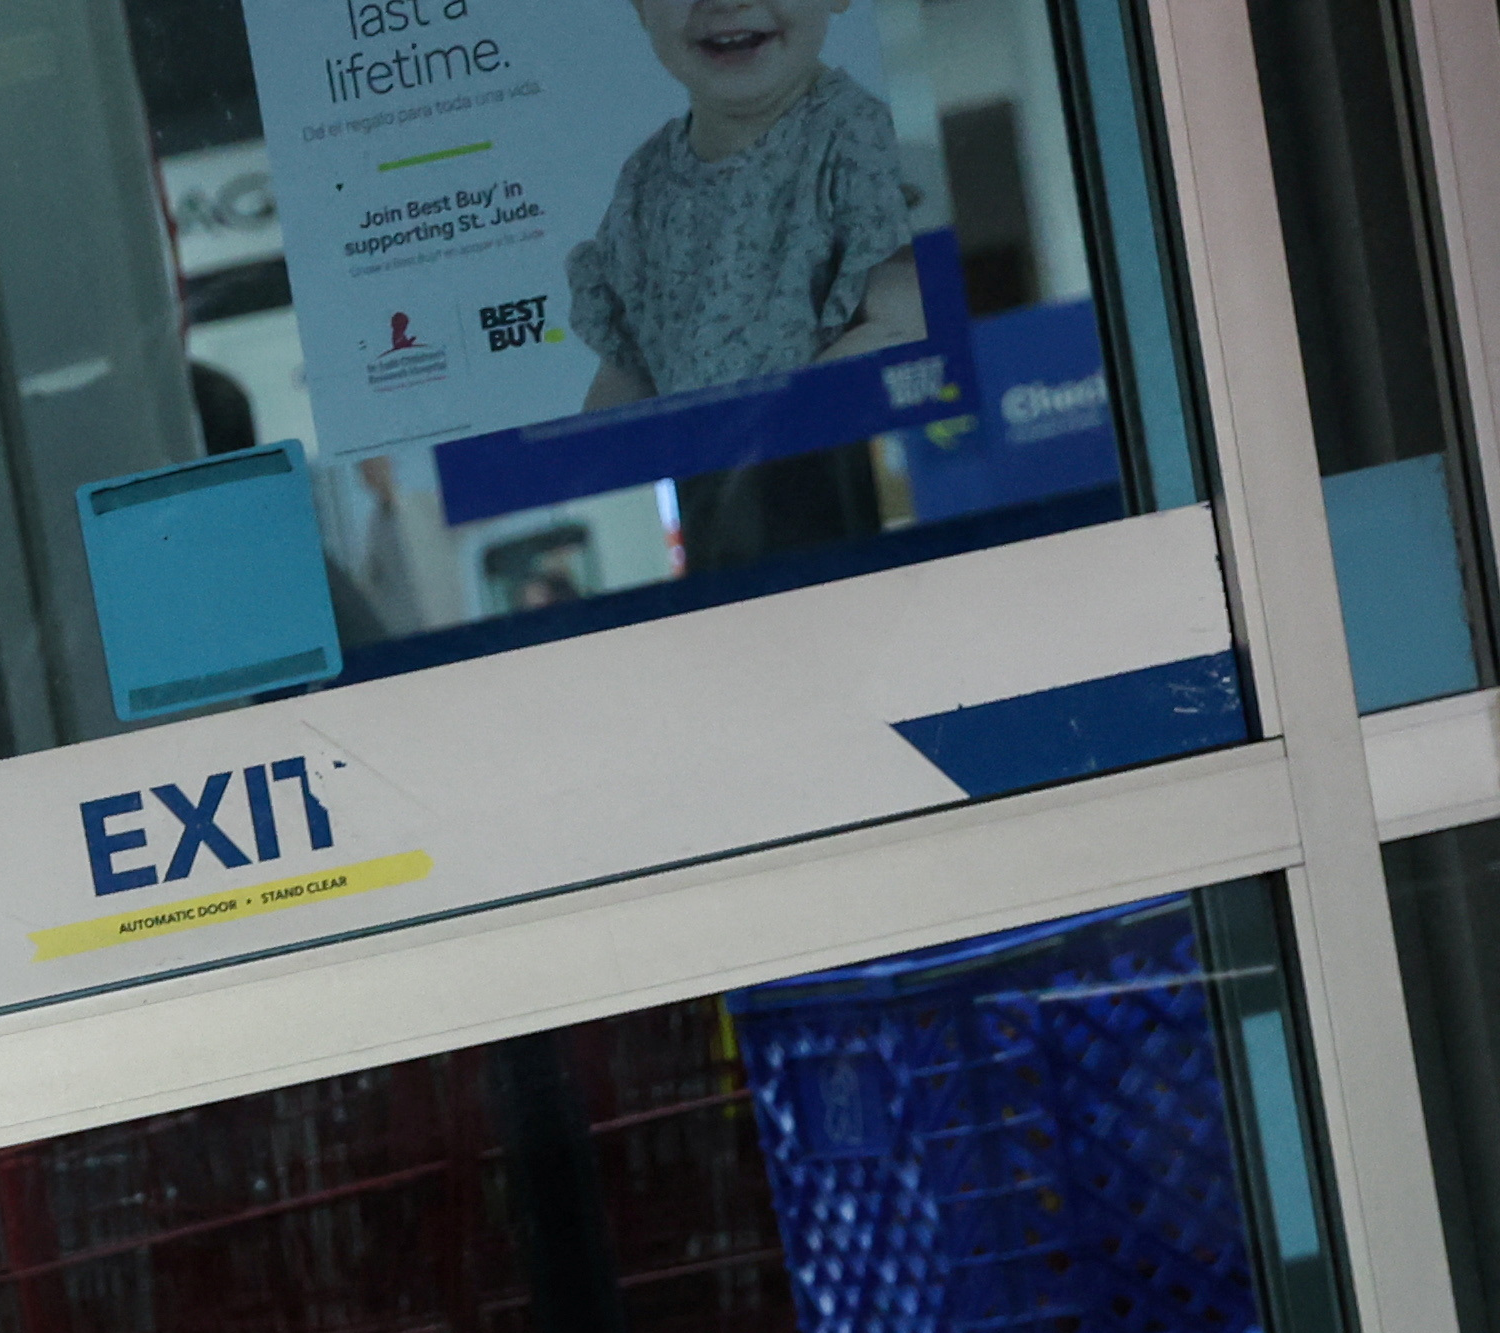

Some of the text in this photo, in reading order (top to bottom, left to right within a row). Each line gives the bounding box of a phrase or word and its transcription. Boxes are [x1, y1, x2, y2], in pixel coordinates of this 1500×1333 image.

[347, 0, 430, 40] last
[325, 39, 510, 103] lifetime.
[345, 220, 455, 256] supporting
[458, 213, 484, 233] St.
[490, 200, 545, 226] Jude.
[360, 206, 403, 230] Join
[407, 193, 451, 219] Best
[503, 180, 522, 199] in
[479, 296, 547, 330] BEST
[80, 755, 338, 897] EXIT
[118, 875, 349, 937] AUTOMATIC DOOR STAND CLEAR
